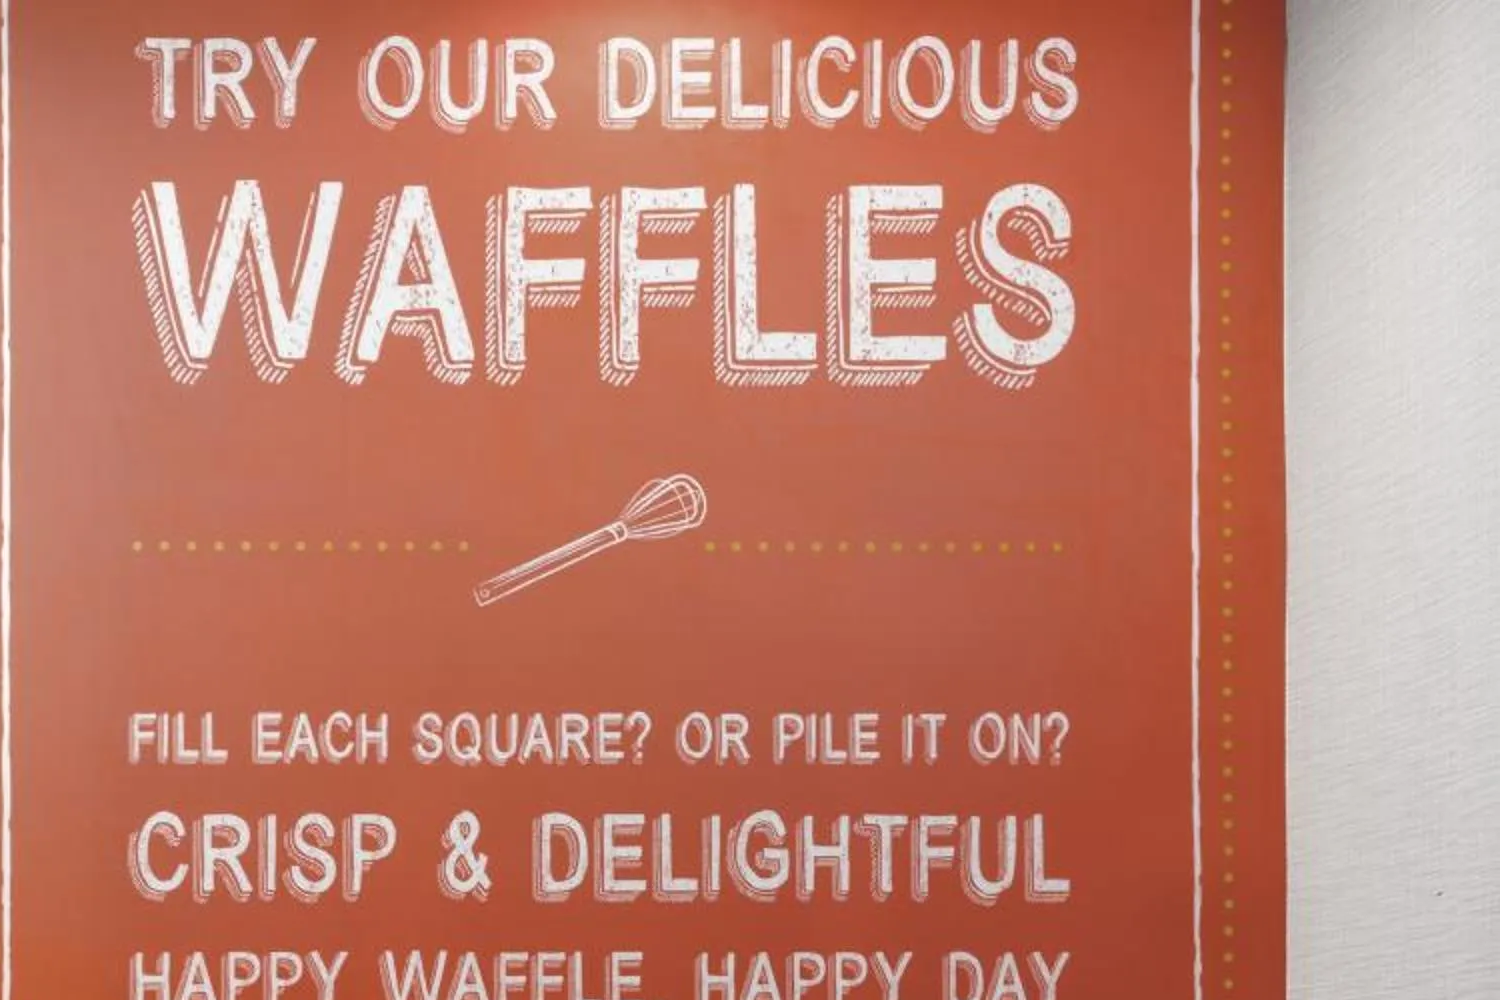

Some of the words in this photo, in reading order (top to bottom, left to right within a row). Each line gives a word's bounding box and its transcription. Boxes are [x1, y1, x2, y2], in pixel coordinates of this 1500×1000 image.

[134, 36, 316, 130] TRY
[359, 36, 557, 131] OUR
[598, 35, 1079, 133] DELICIOUS
[132, 180, 1077, 389] WAFFLES
[128, 711, 229, 765] FILL
[251, 711, 388, 765] EACH
[412, 711, 651, 765] SQUARE?
[676, 711, 750, 765] OR
[772, 711, 880, 765] PILE
[901, 711, 947, 765] IT
[969, 711, 1069, 765] ON?
[128, 811, 397, 904] CRISP
[438, 811, 492, 903] &
[531, 811, 1071, 904] DELIGHTFUL
